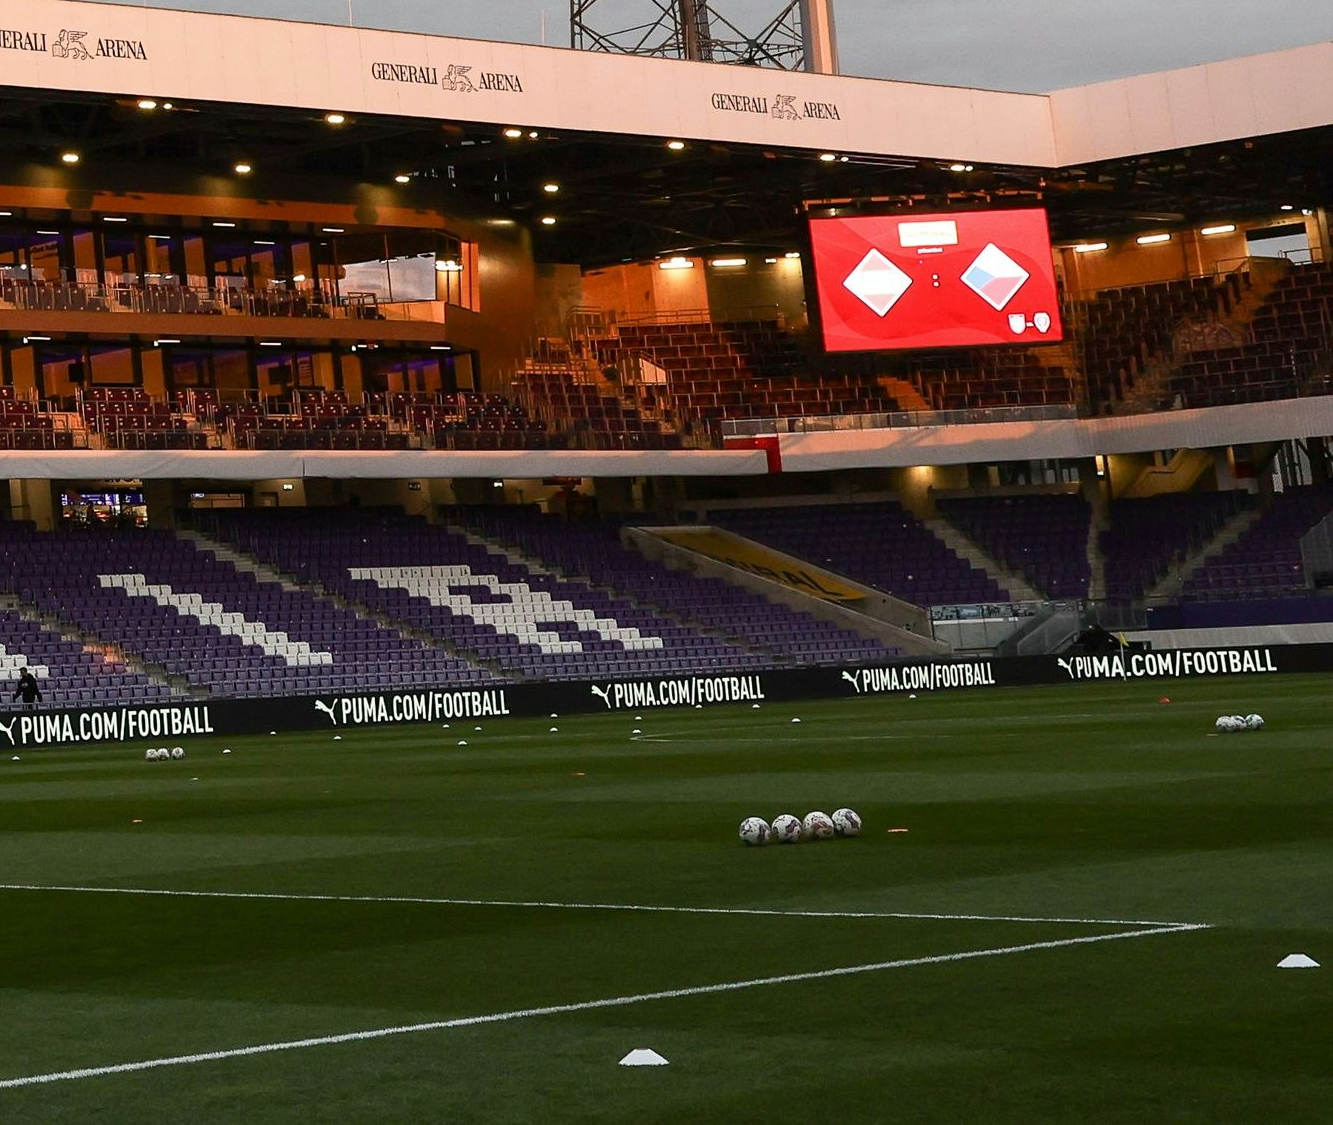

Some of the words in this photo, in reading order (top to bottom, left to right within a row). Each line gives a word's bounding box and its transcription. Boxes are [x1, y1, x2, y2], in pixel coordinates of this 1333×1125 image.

[95, 38, 148, 61] ARENA
[371, 62, 438, 85] GENERALI
[479, 72, 523, 93] ARENA
[711, 92, 768, 114] GENERALI
[802, 101, 841, 121] ARENA
[862, 662, 996, 692] PUMA.COM/FOOTBALL
[1075, 649, 1278, 679] PUMA.COM/FOOTBALL
[341, 689, 510, 724] PUMA.COM/FOOTBALL
[614, 676, 765, 708] PUMA.COM/FOOTBALL
[20, 706, 214, 744] PUMA.COM/FOOTBALL
